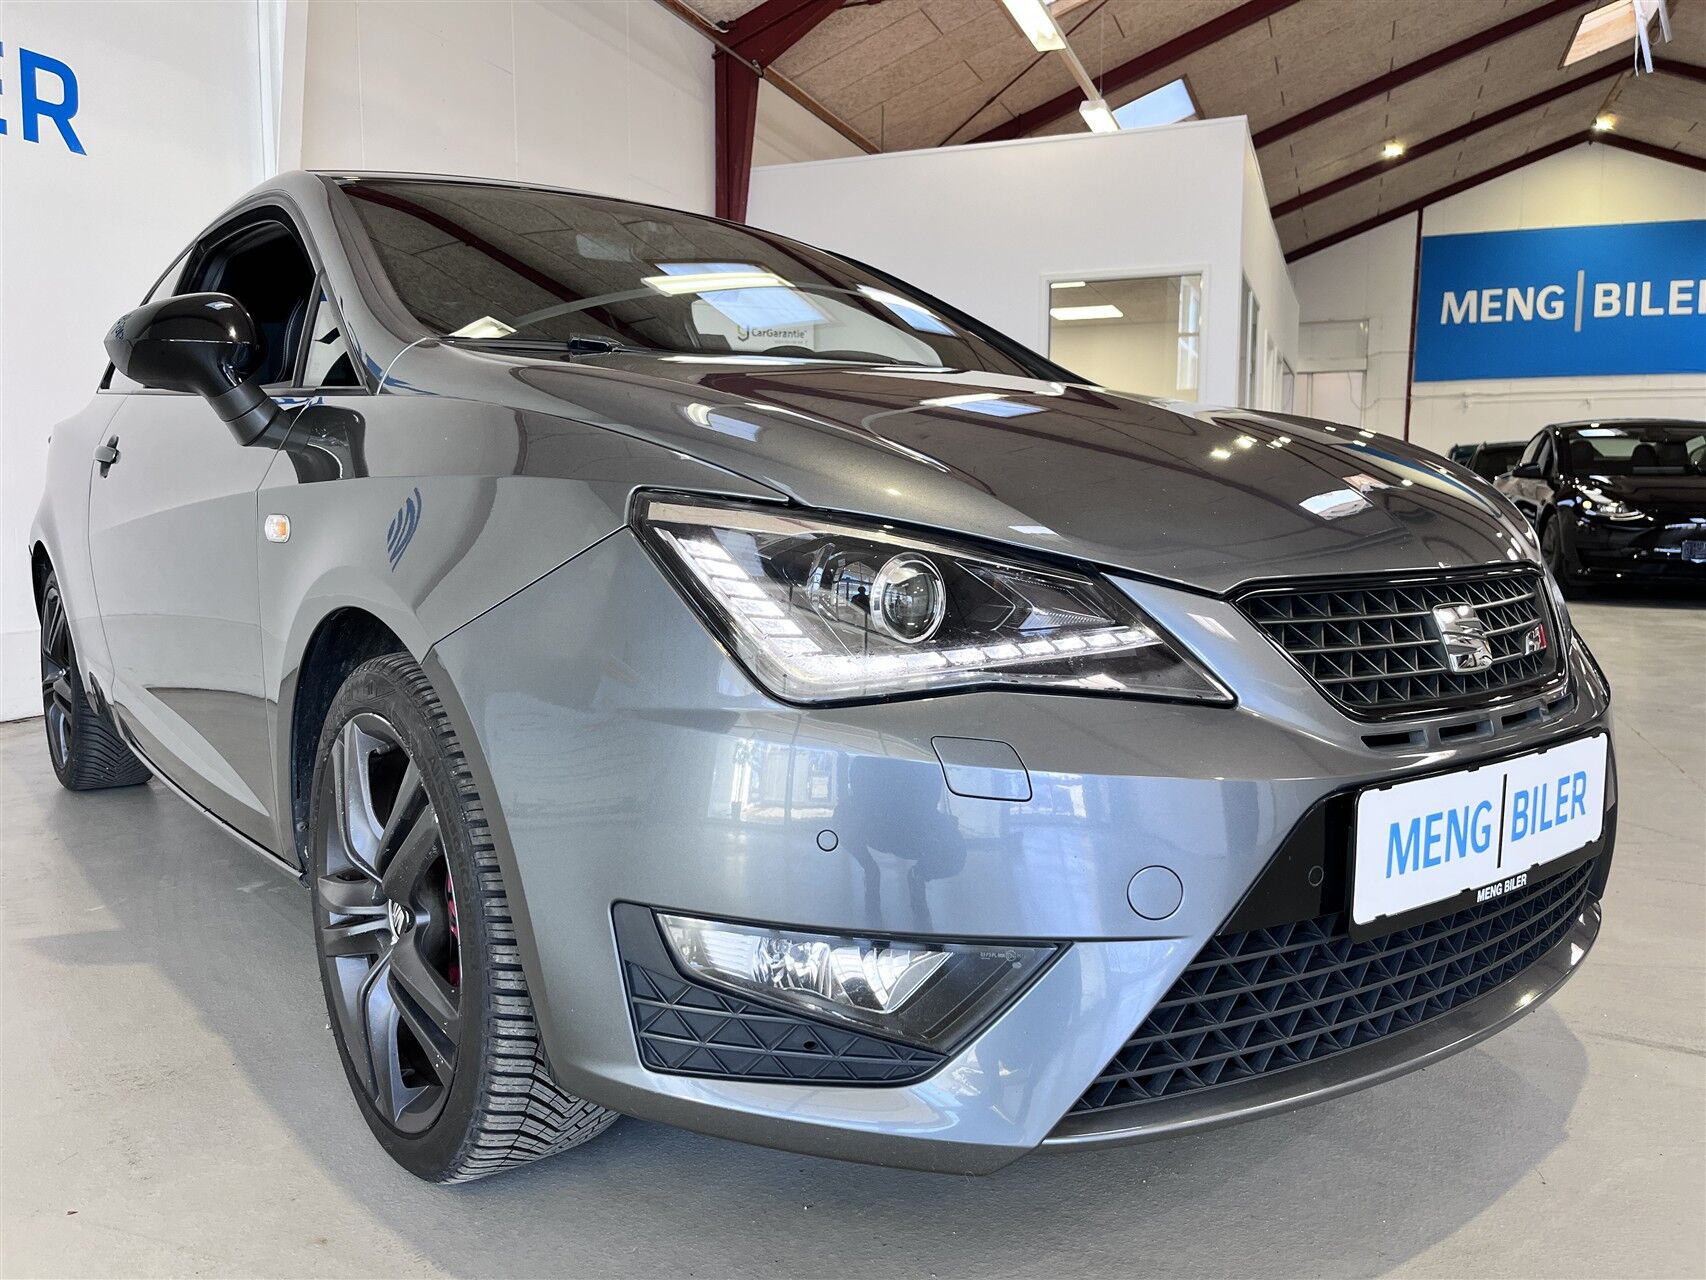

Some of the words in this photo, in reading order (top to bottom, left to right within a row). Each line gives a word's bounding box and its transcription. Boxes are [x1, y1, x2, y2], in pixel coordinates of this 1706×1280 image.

[0, 41, 87, 156] R
[1440, 284, 1565, 325] MENG
[751, 328, 806, 339] CarGarantie
[1385, 800, 1492, 879] MENG
[1511, 770, 1587, 842] BILER
[1476, 882, 1503, 903] MENG
[1503, 873, 1527, 893] BILER
